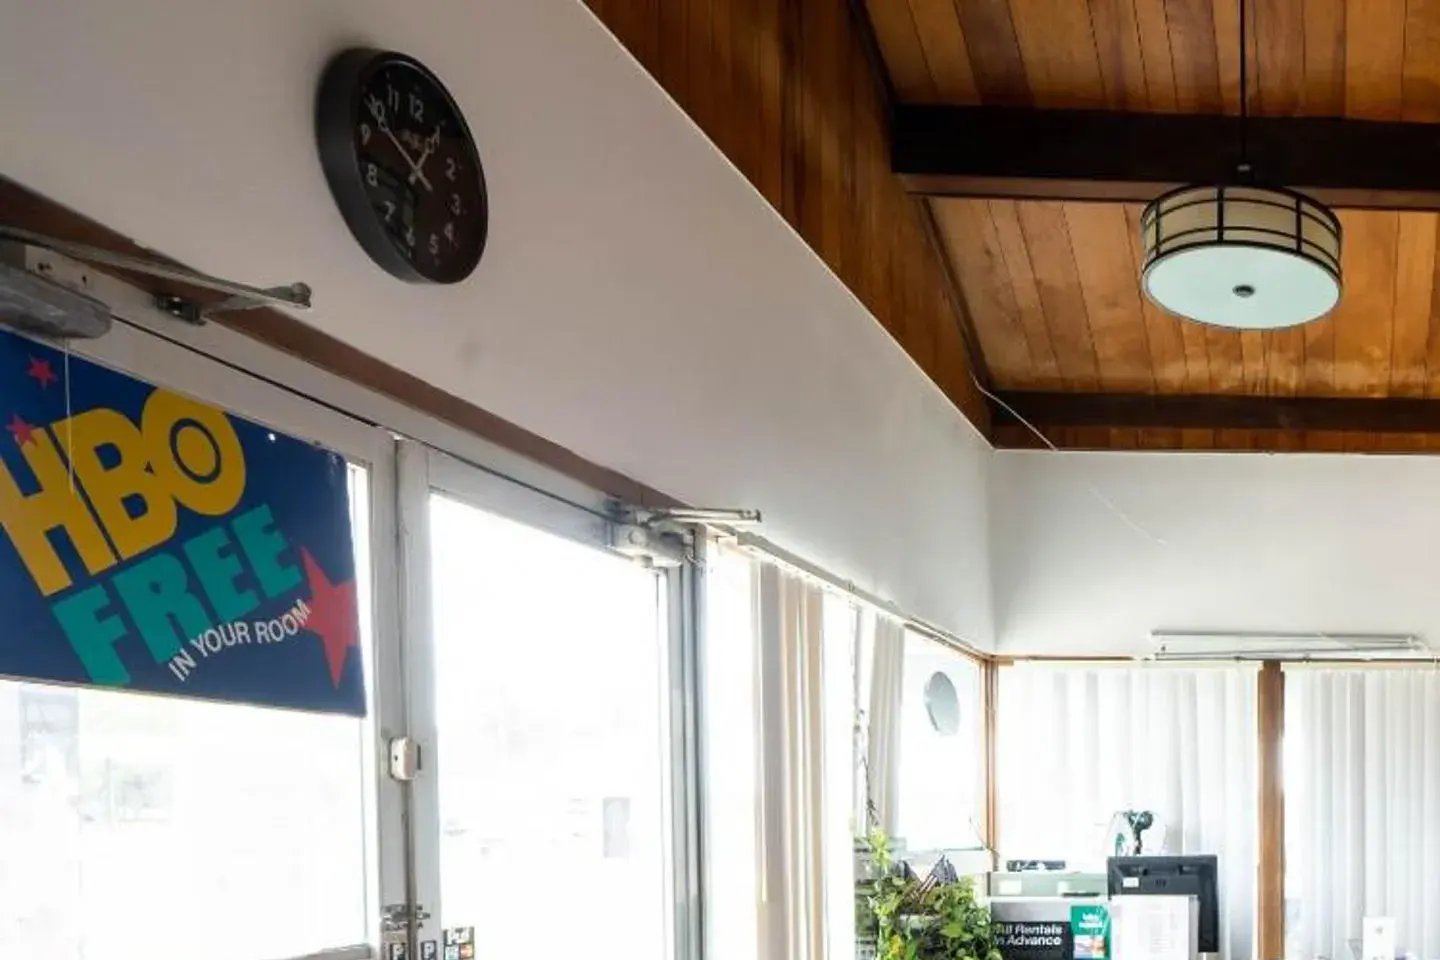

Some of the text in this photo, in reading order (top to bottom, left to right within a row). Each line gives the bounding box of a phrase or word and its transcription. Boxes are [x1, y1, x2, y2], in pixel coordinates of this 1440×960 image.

[409, 93, 424, 123] 12
[366, 163, 379, 187] 8
[446, 157, 457, 181] 2
[0, 387, 246, 597] HBO
[50, 503, 303, 687] FREE
[168, 598, 313, 683] IN YOUR ROOM
[1007, 935, 1062, 945] Advance
[1015, 923, 1064, 935] Rentals
